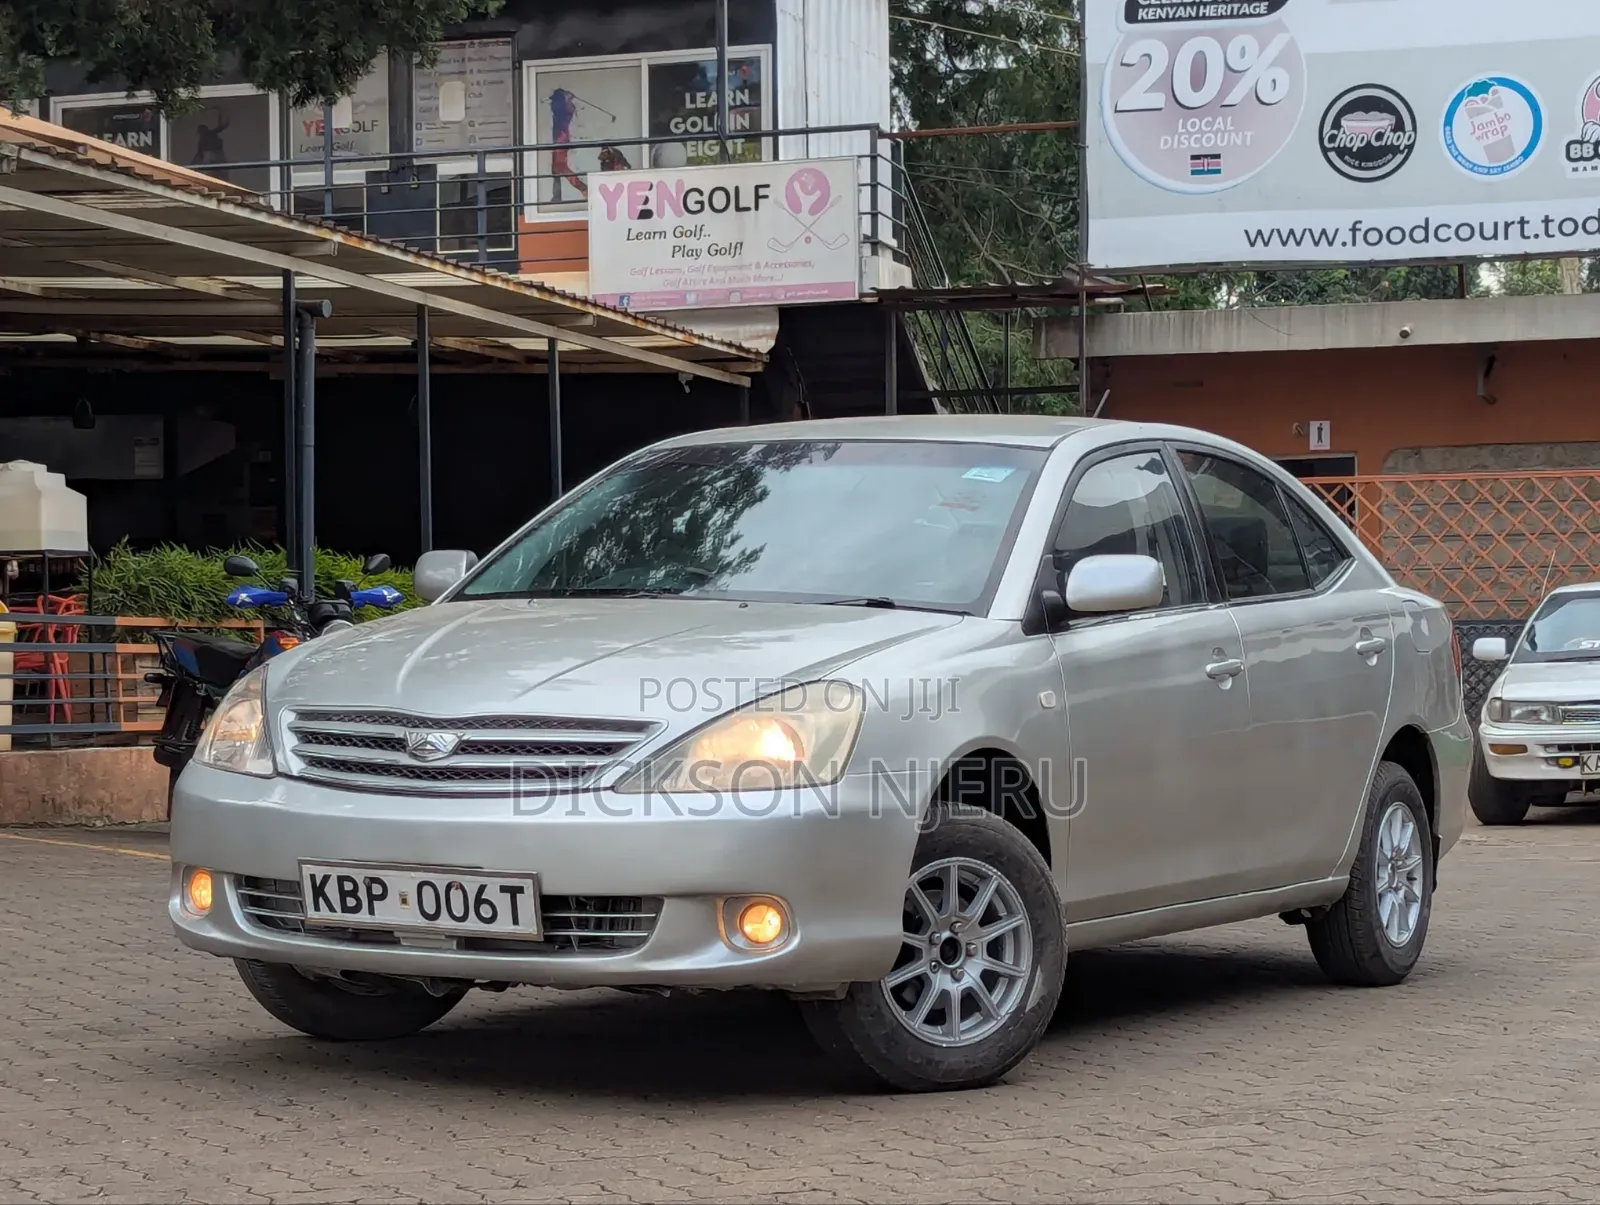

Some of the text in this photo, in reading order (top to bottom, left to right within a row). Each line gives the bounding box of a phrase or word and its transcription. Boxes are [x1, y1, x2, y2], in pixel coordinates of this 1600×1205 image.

[1138, 2, 1269, 20] KENYAN HERITAGE
[1115, 33, 1291, 113] 20%
[730, 113, 749, 130] IN
[1178, 116, 1235, 133] LOCAL
[1470, 112, 1511, 135] Jambo
[94, 131, 152, 147] EARN
[1160, 131, 1254, 150] DISCOUNT
[1324, 125, 1415, 152] Chop Chop
[1475, 124, 1508, 141] wrap
[626, 228, 667, 241] Learn
[1244, 208, 1600, 248] www.foodcourt.tod
[671, 241, 743, 260] Play Golf!
[309, 873, 525, 926] KBP 006T
